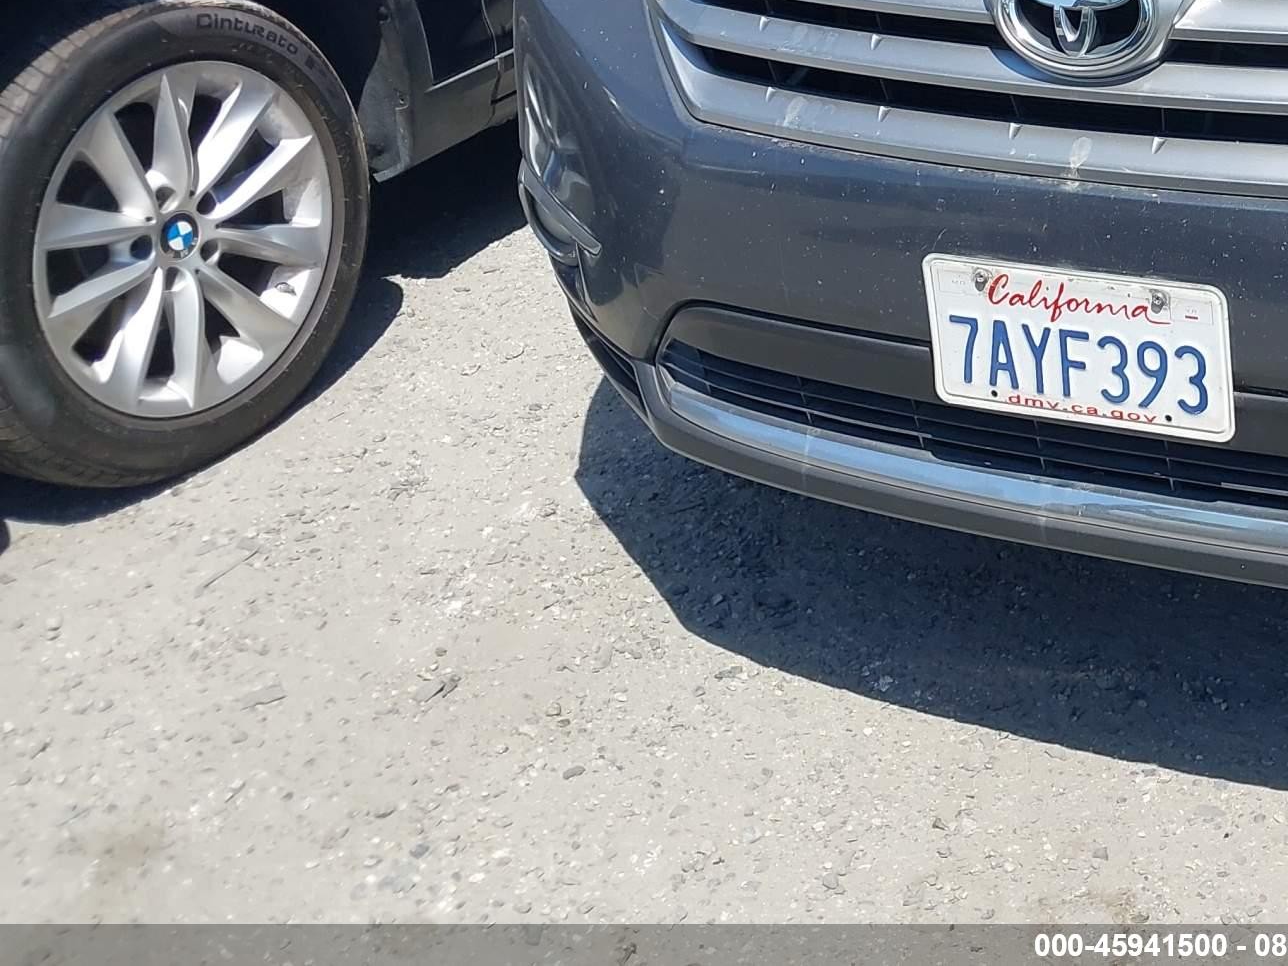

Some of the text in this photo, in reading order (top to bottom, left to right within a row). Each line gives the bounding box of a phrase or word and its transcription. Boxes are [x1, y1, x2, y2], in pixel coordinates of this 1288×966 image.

[196, 12, 299, 55] Cinturato
[987, 273, 1171, 324] California
[948, 314, 1209, 415] 7AYF393
[1007, 394, 1158, 424] dmv.ca.gov
